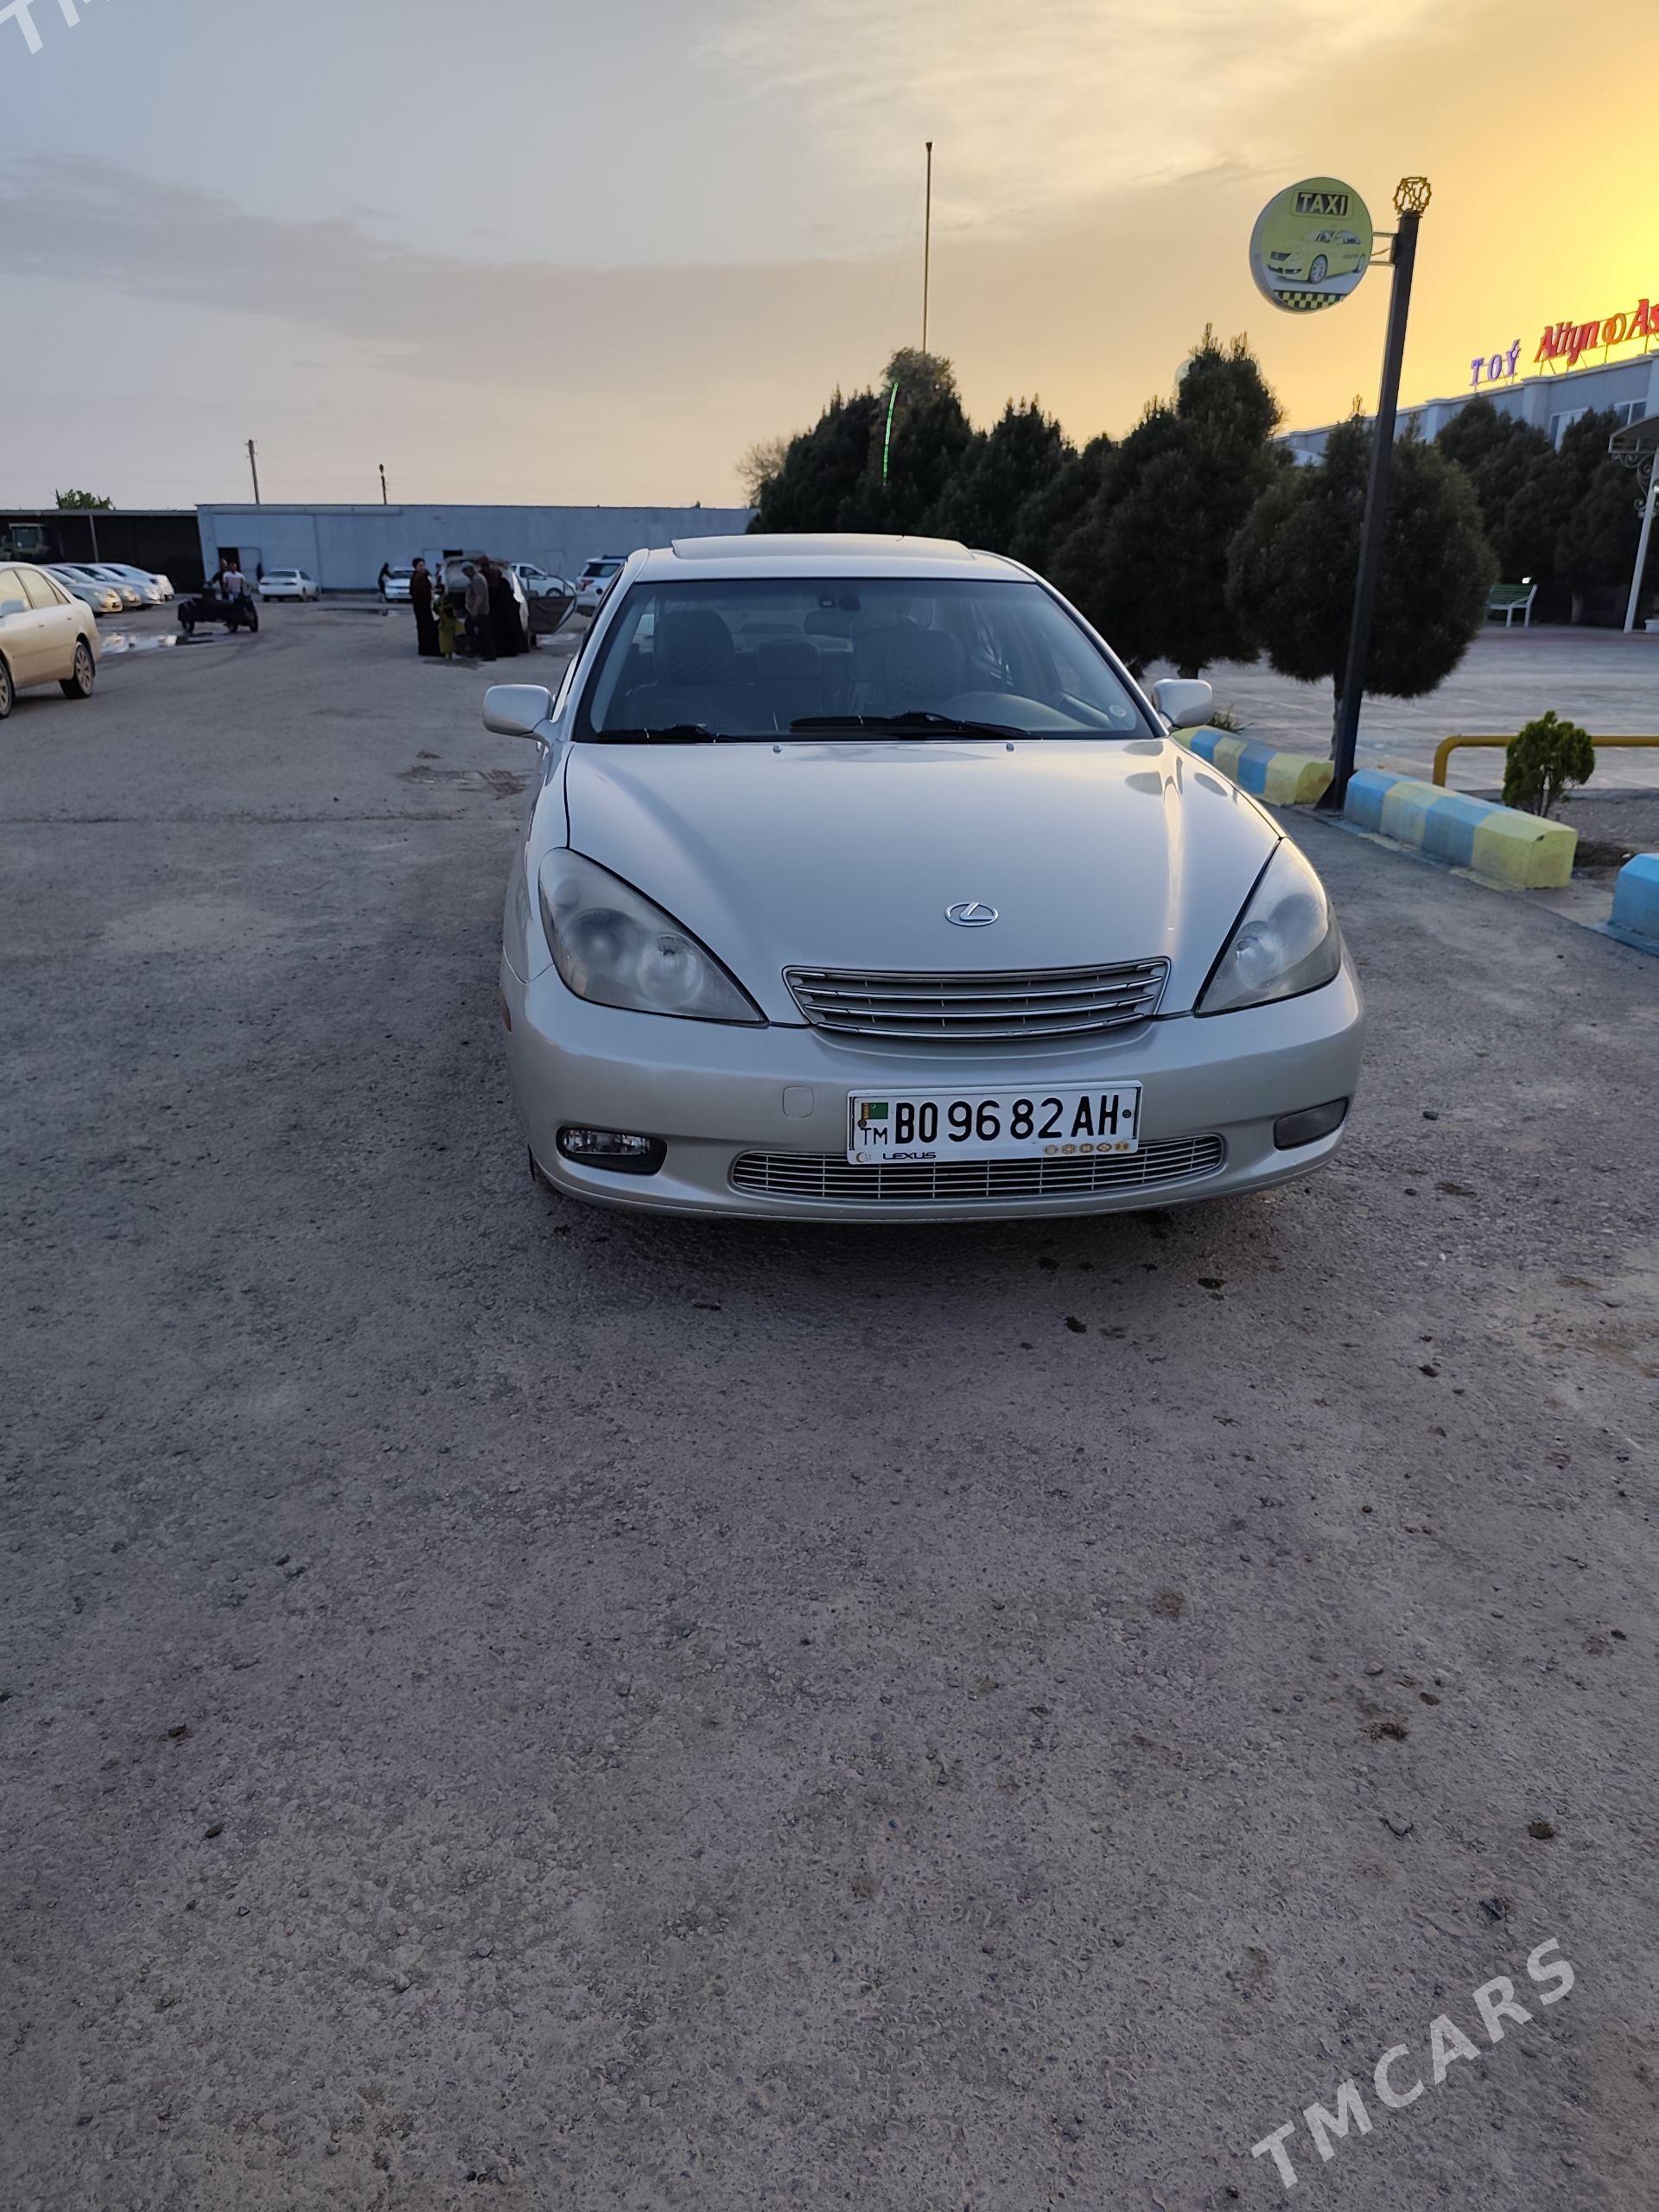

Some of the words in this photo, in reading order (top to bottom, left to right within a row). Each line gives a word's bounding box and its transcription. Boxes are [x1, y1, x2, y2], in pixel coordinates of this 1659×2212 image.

[1300, 193, 1347, 216] TAXI
[861, 1127, 888, 1146] TM
[882, 1151, 937, 1160] LEXUS
